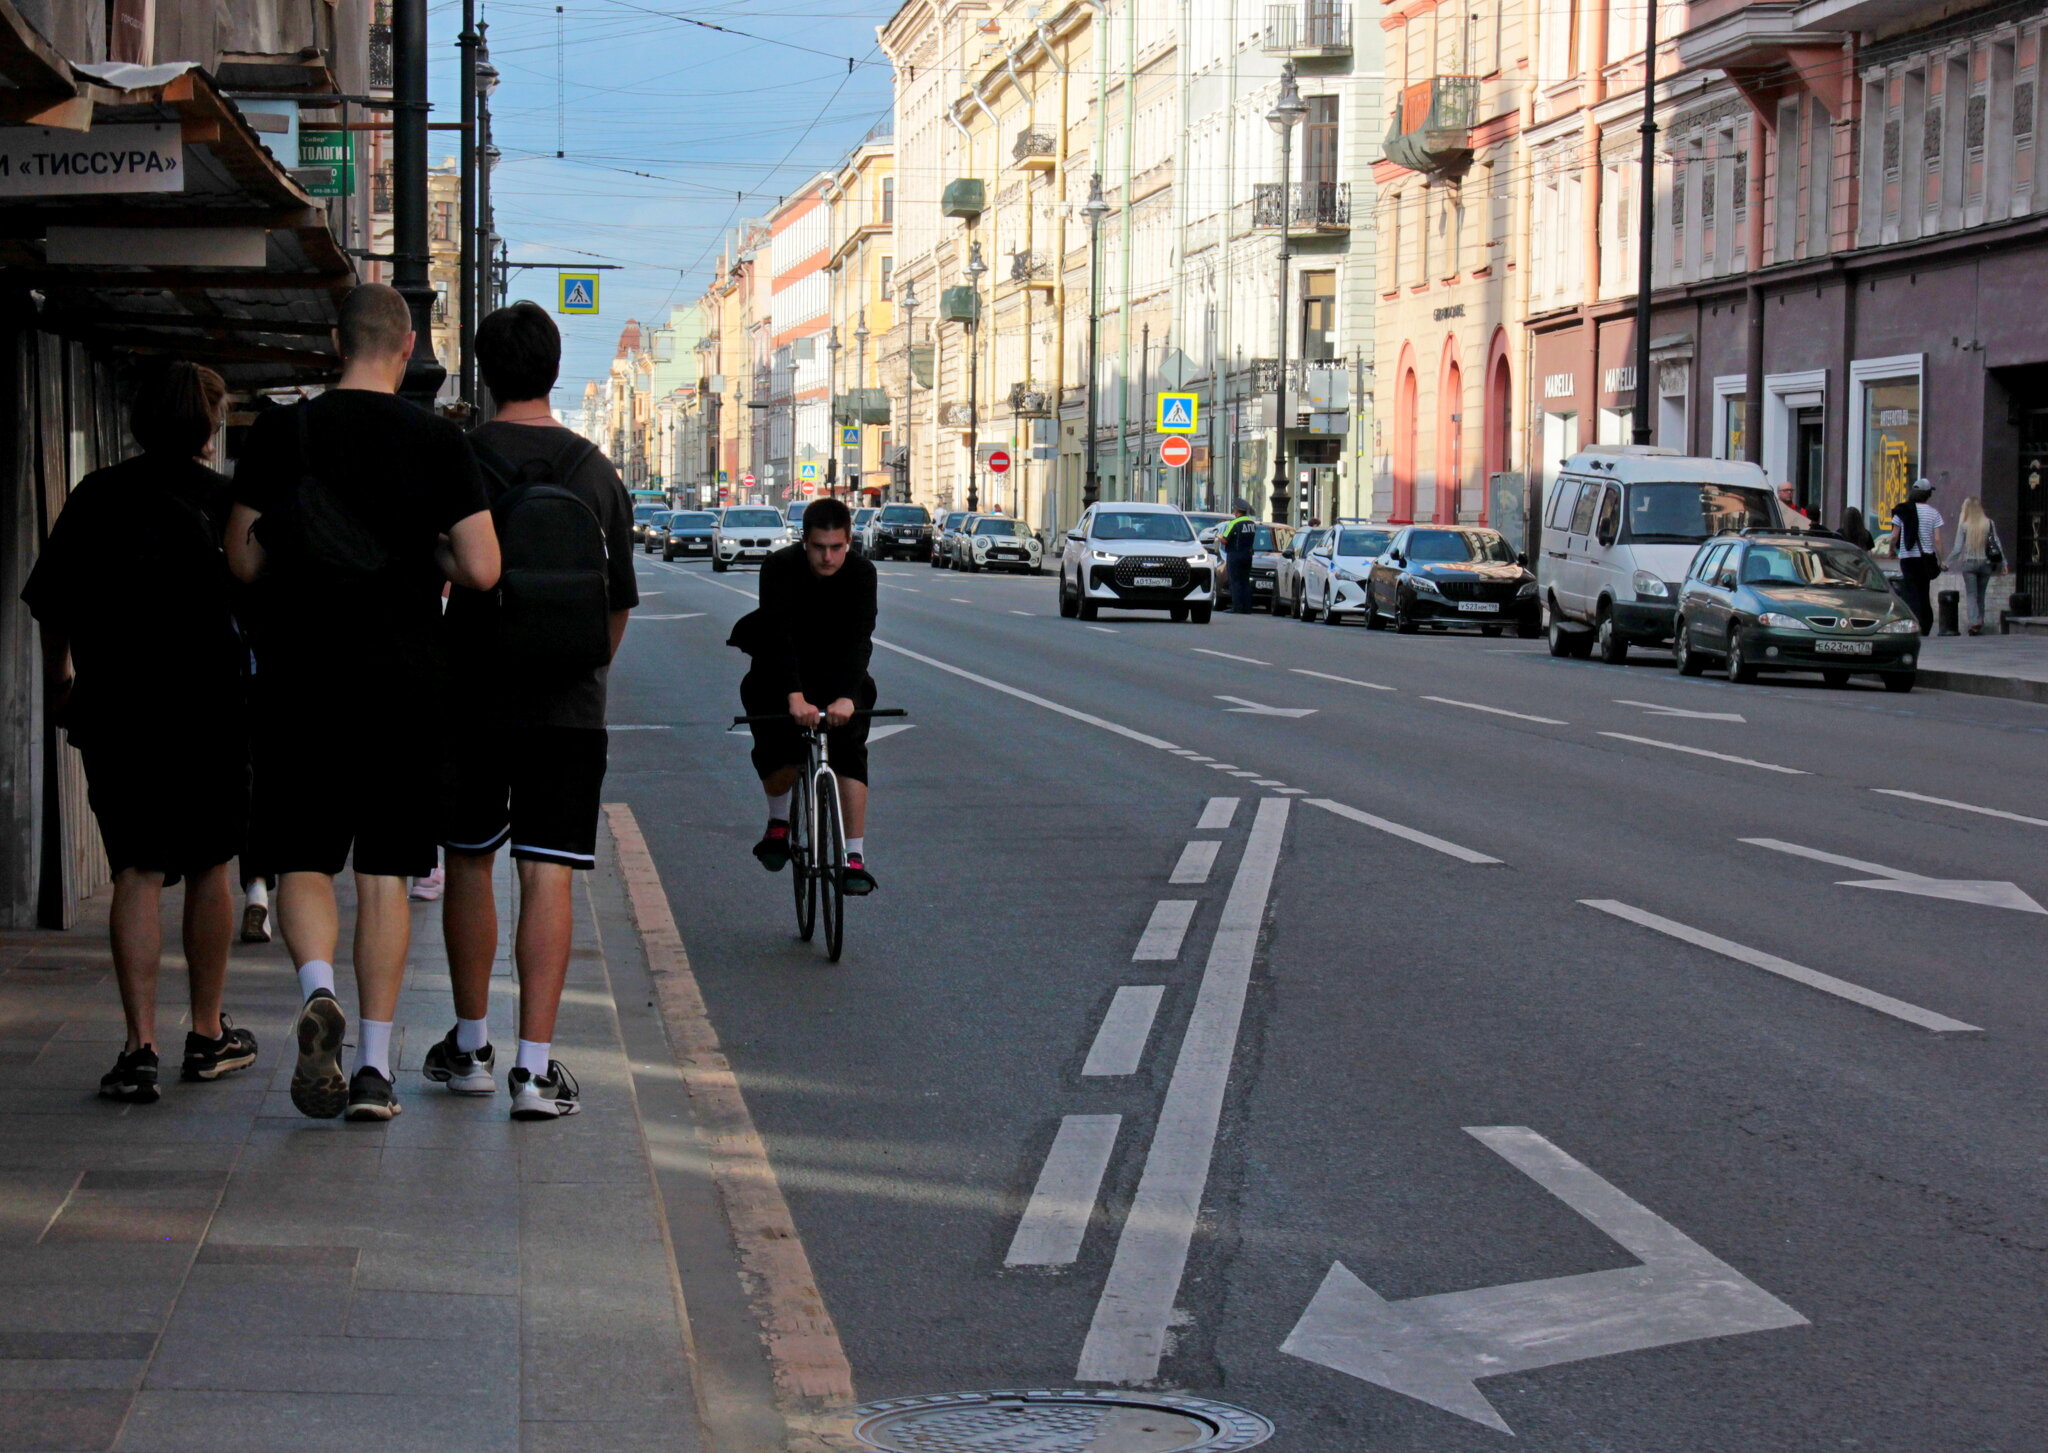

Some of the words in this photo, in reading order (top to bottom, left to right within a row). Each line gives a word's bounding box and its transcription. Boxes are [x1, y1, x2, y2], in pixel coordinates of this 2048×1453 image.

[19, 151, 177, 176] «ТИССУРА»
[1545, 373, 1574, 398] MARELLA
[1605, 366, 1637, 393] MARELLA
